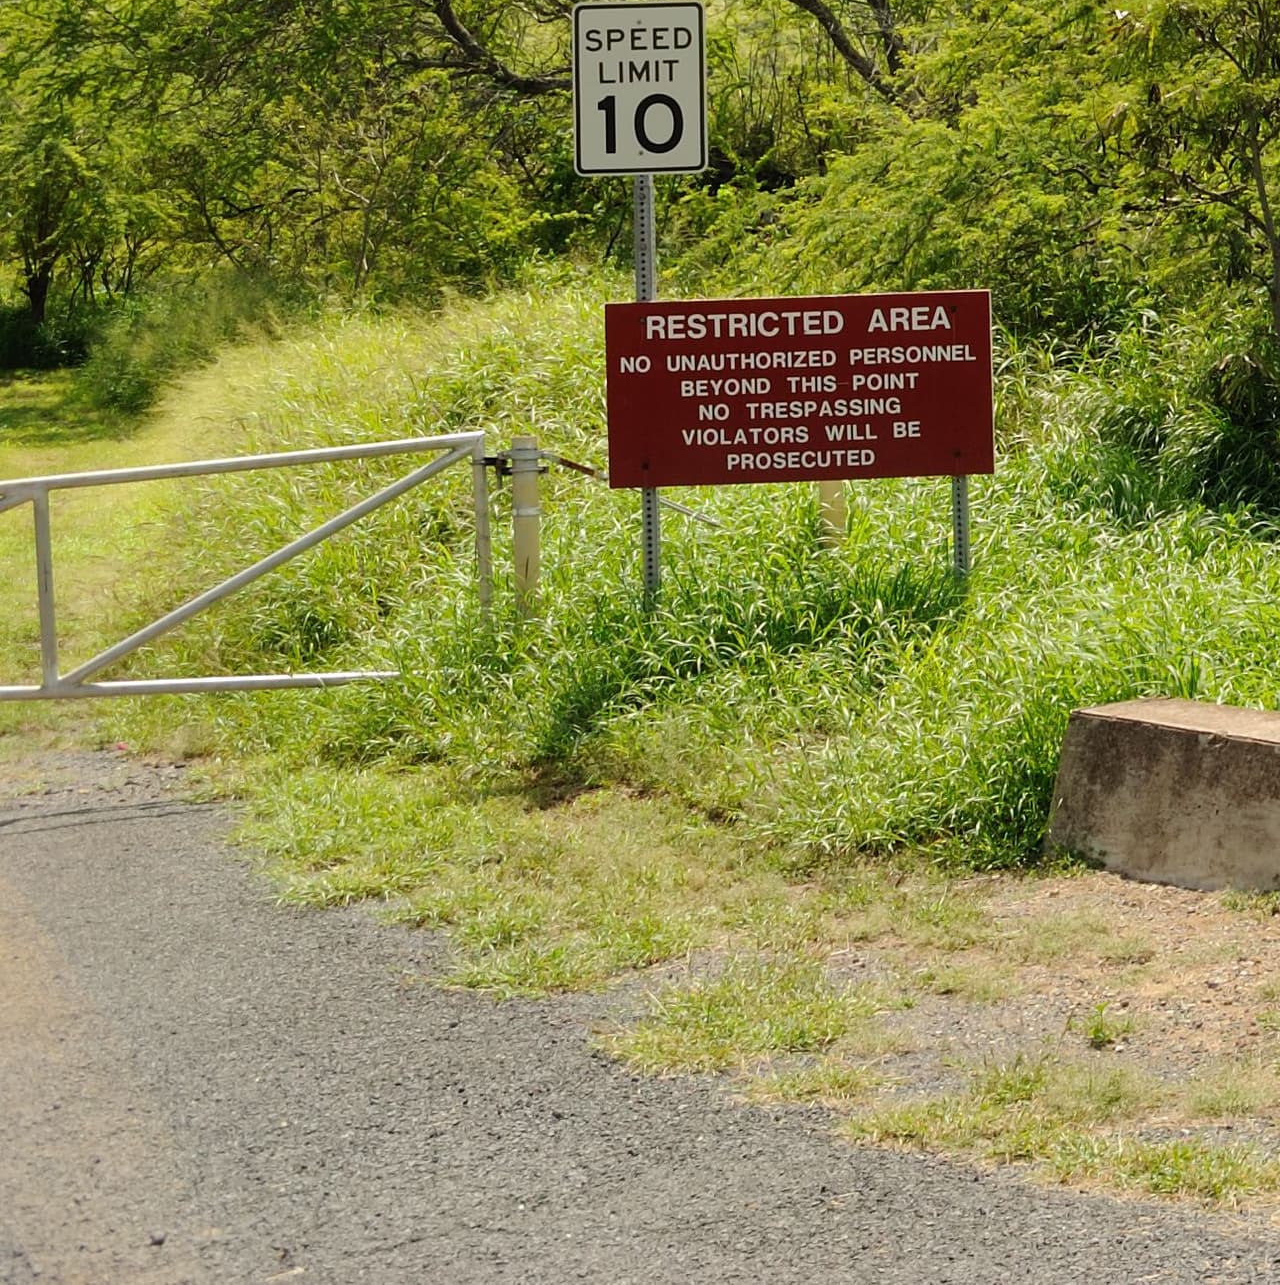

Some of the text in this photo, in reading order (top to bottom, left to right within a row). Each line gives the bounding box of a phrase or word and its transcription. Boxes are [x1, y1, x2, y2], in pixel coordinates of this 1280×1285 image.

[586, 27, 691, 51] SPEED
[599, 60, 679, 83] LIMIT
[598, 94, 683, 154] 10
[647, 306, 950, 339] RESTRICTED AREA
[621, 345, 976, 373] NO UNAUTHORIZED PERSONNEL
[681, 373, 919, 396] BEYOND THIS POINT
[699, 398, 901, 420] NO TRESPASSING
[682, 421, 920, 445] VIOLATORS WILL BE
[728, 450, 875, 470] PROSECUTED
